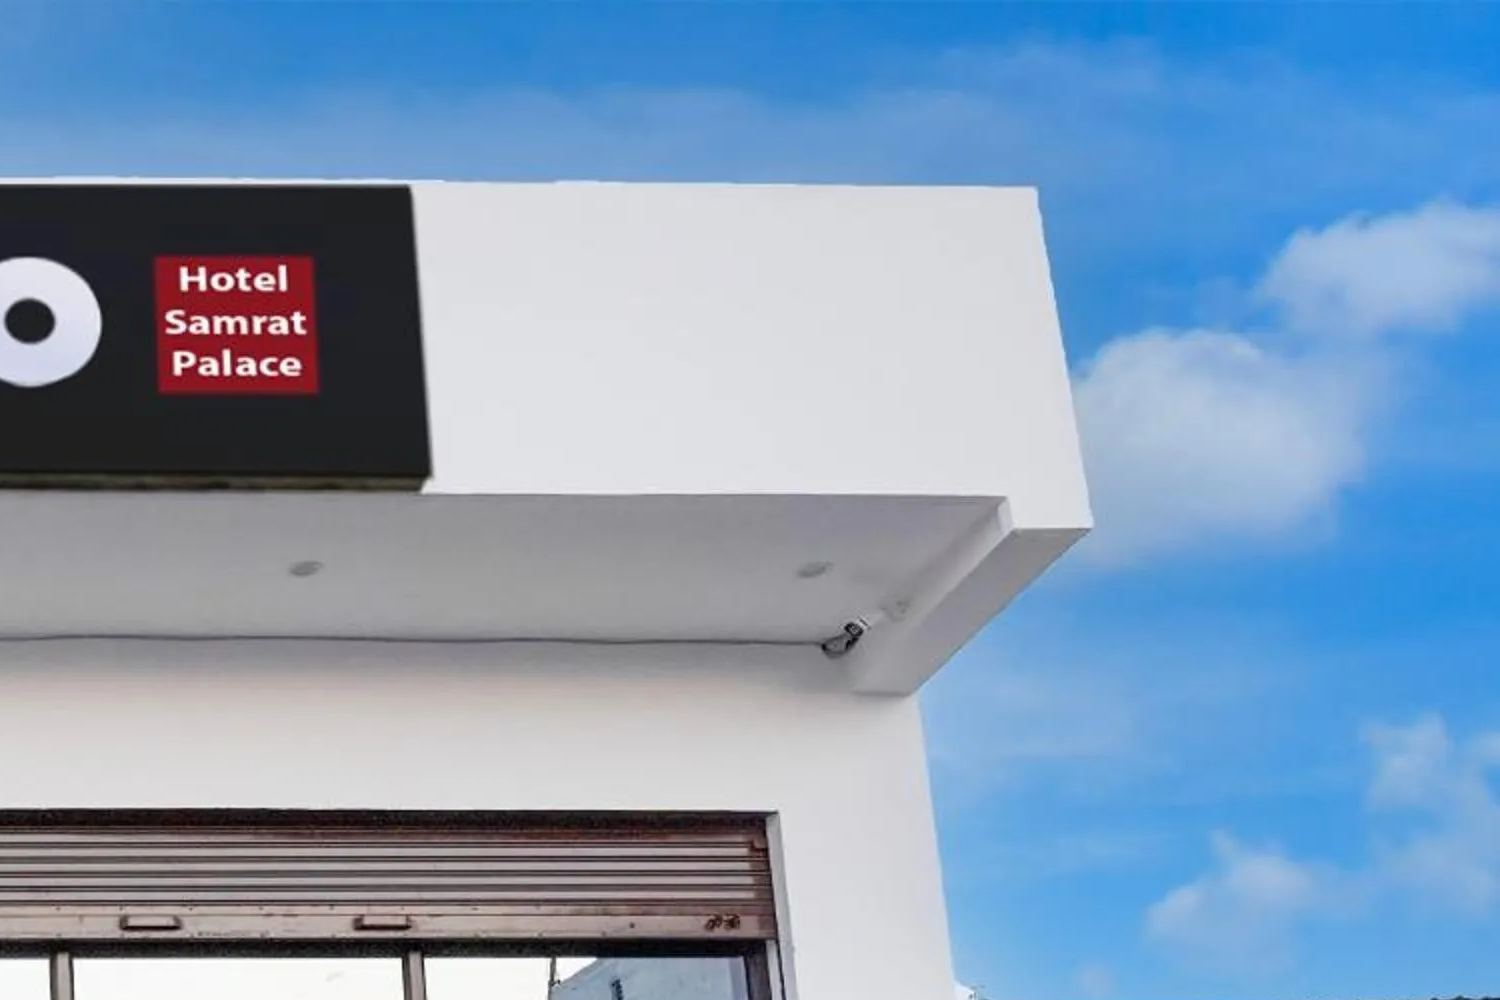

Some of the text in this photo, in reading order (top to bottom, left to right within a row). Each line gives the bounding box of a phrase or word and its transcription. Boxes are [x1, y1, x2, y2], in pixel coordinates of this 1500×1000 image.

[179, 264, 289, 293] Hotel
[165, 309, 308, 336] Samrat
[173, 349, 303, 378] Palace
